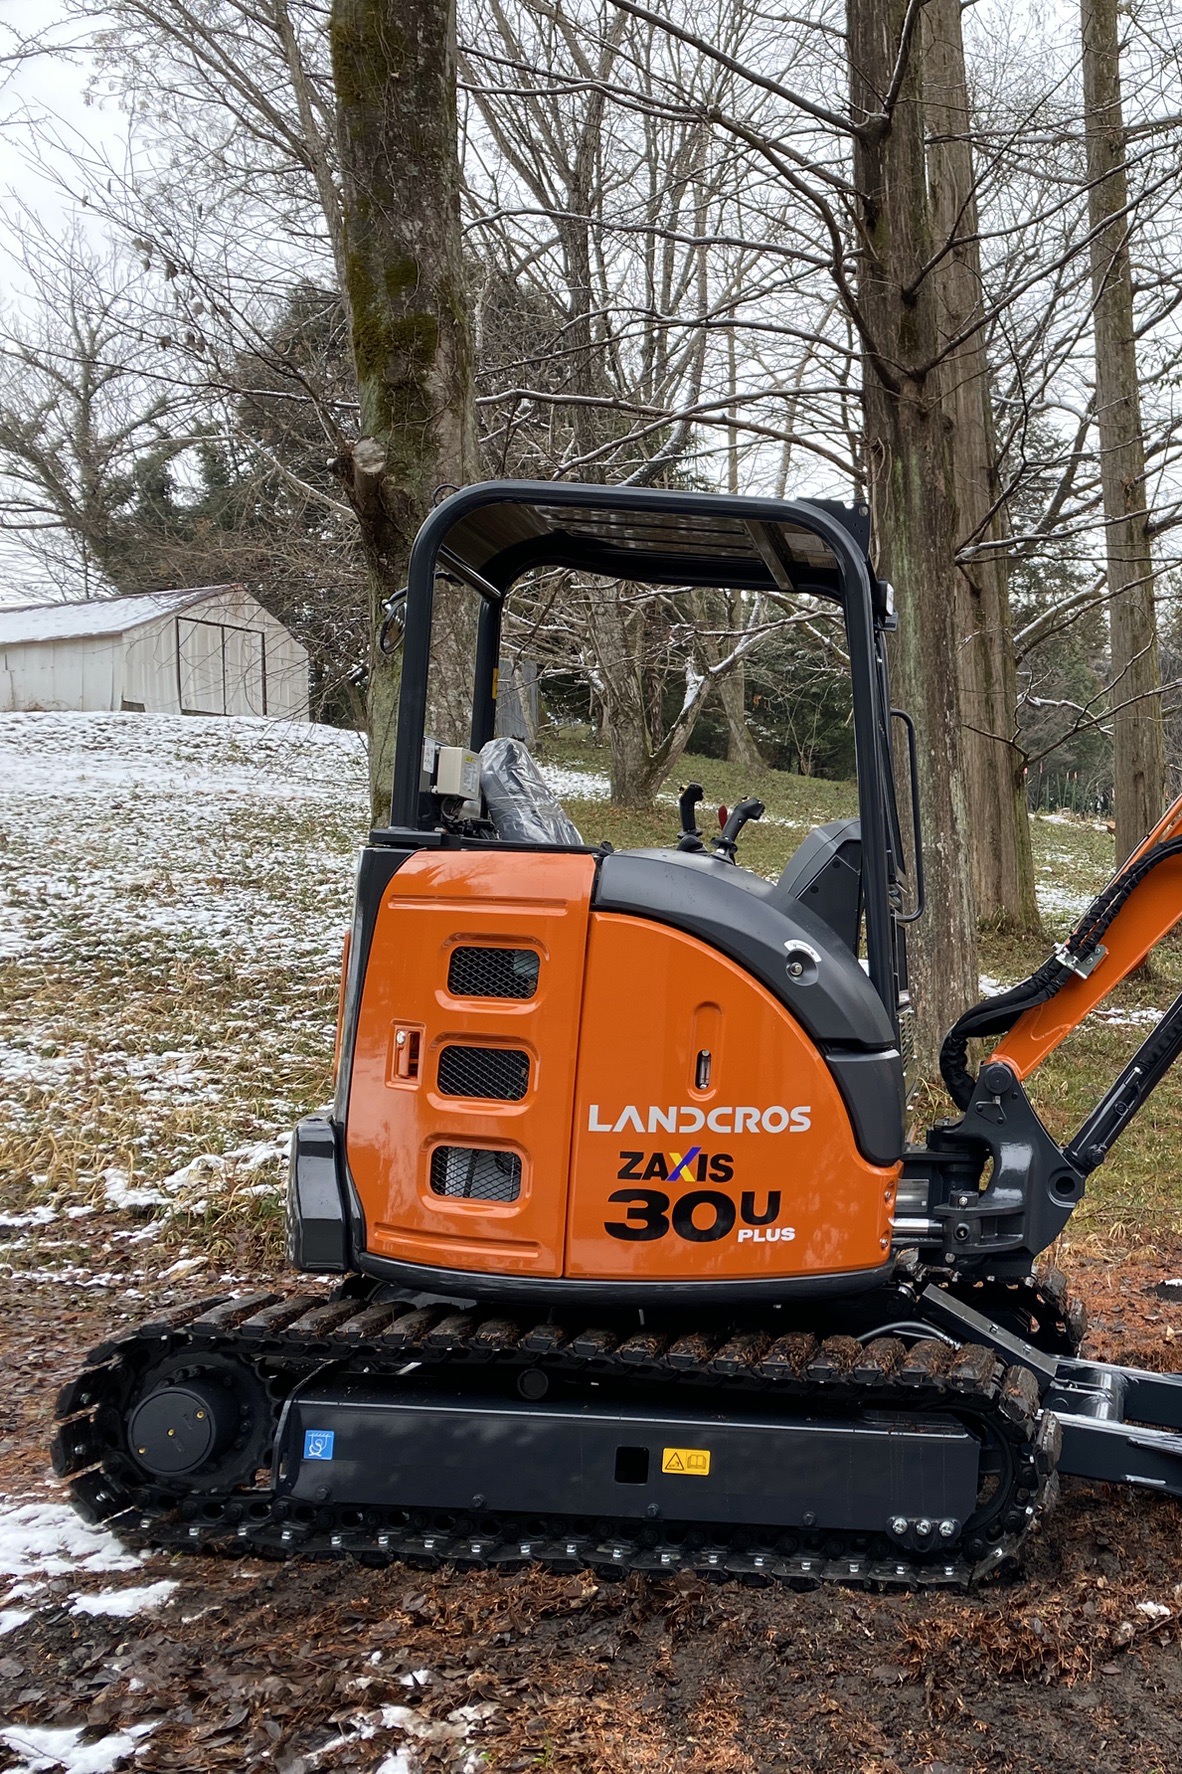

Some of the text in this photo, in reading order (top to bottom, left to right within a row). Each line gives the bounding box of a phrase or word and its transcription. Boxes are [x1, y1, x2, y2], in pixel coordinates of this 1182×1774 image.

[587, 1104, 812, 1134] LANDCROS
[616, 1146, 735, 1183] ZAXIS
[737, 1227, 796, 1243] PLUS
